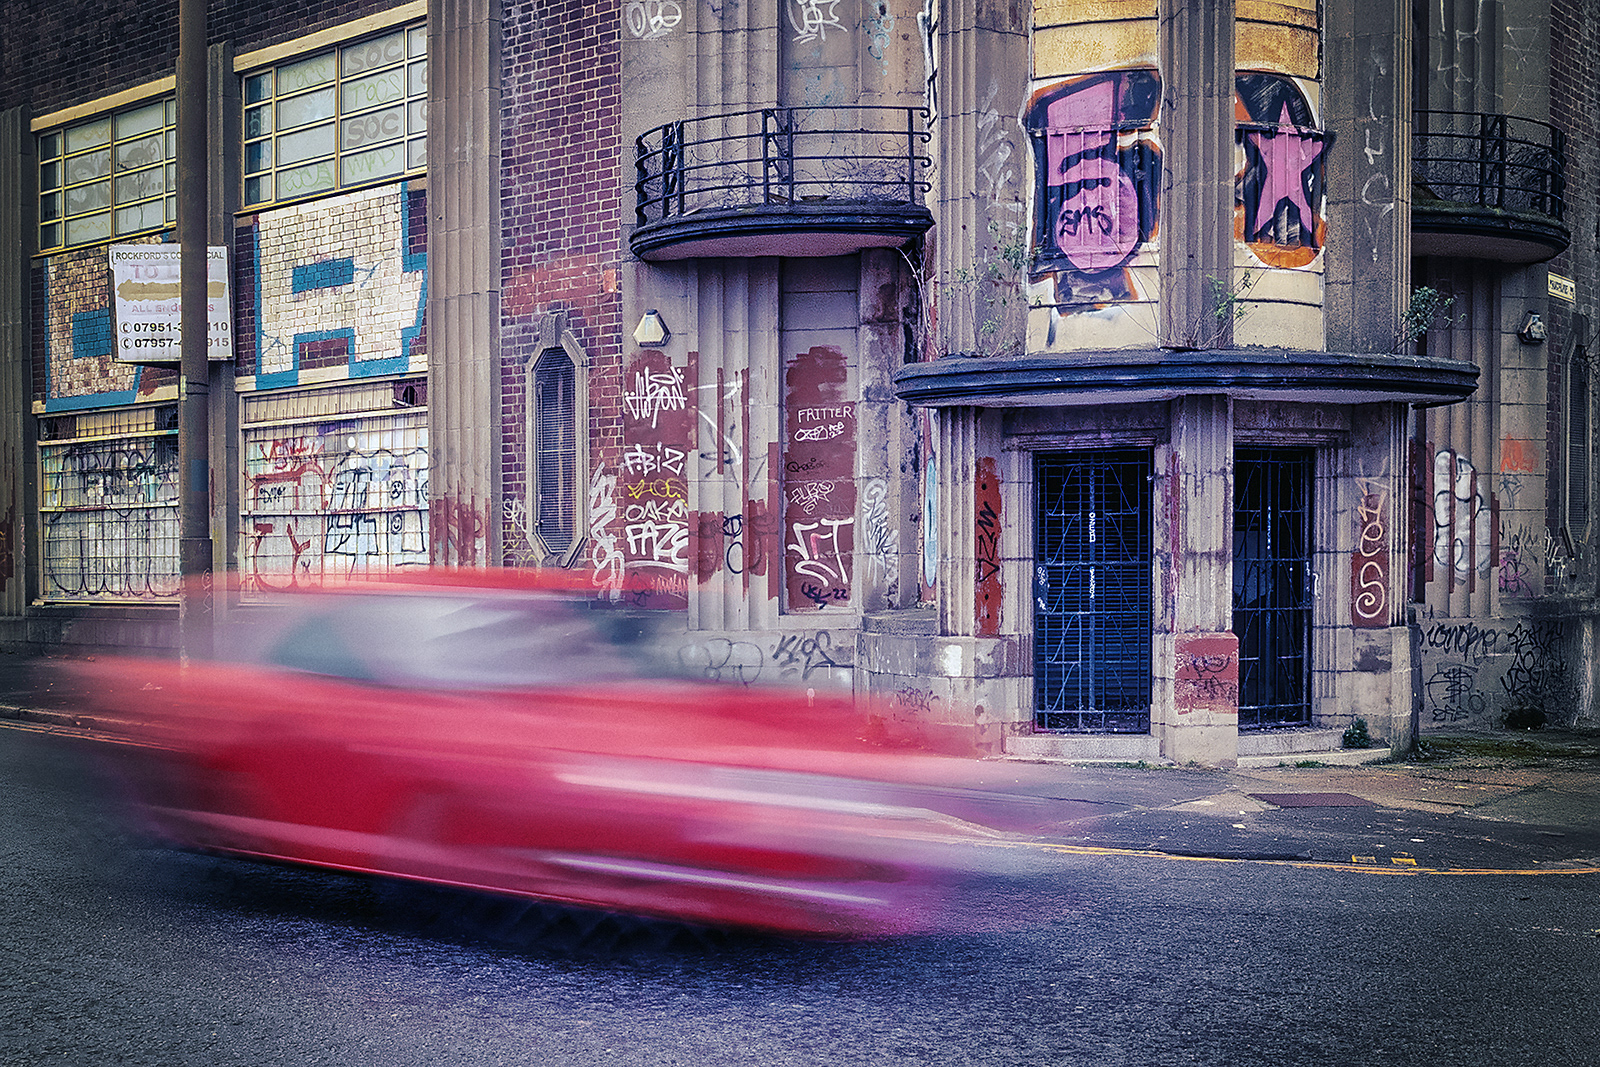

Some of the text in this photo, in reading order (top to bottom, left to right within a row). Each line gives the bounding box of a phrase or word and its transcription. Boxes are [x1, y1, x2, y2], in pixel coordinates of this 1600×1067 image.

[115, 251, 169, 260] ROCKFORD'S
[129, 264, 158, 279] TO
[131, 304, 152, 313] ALL
[797, 405, 853, 423] FRITTER
